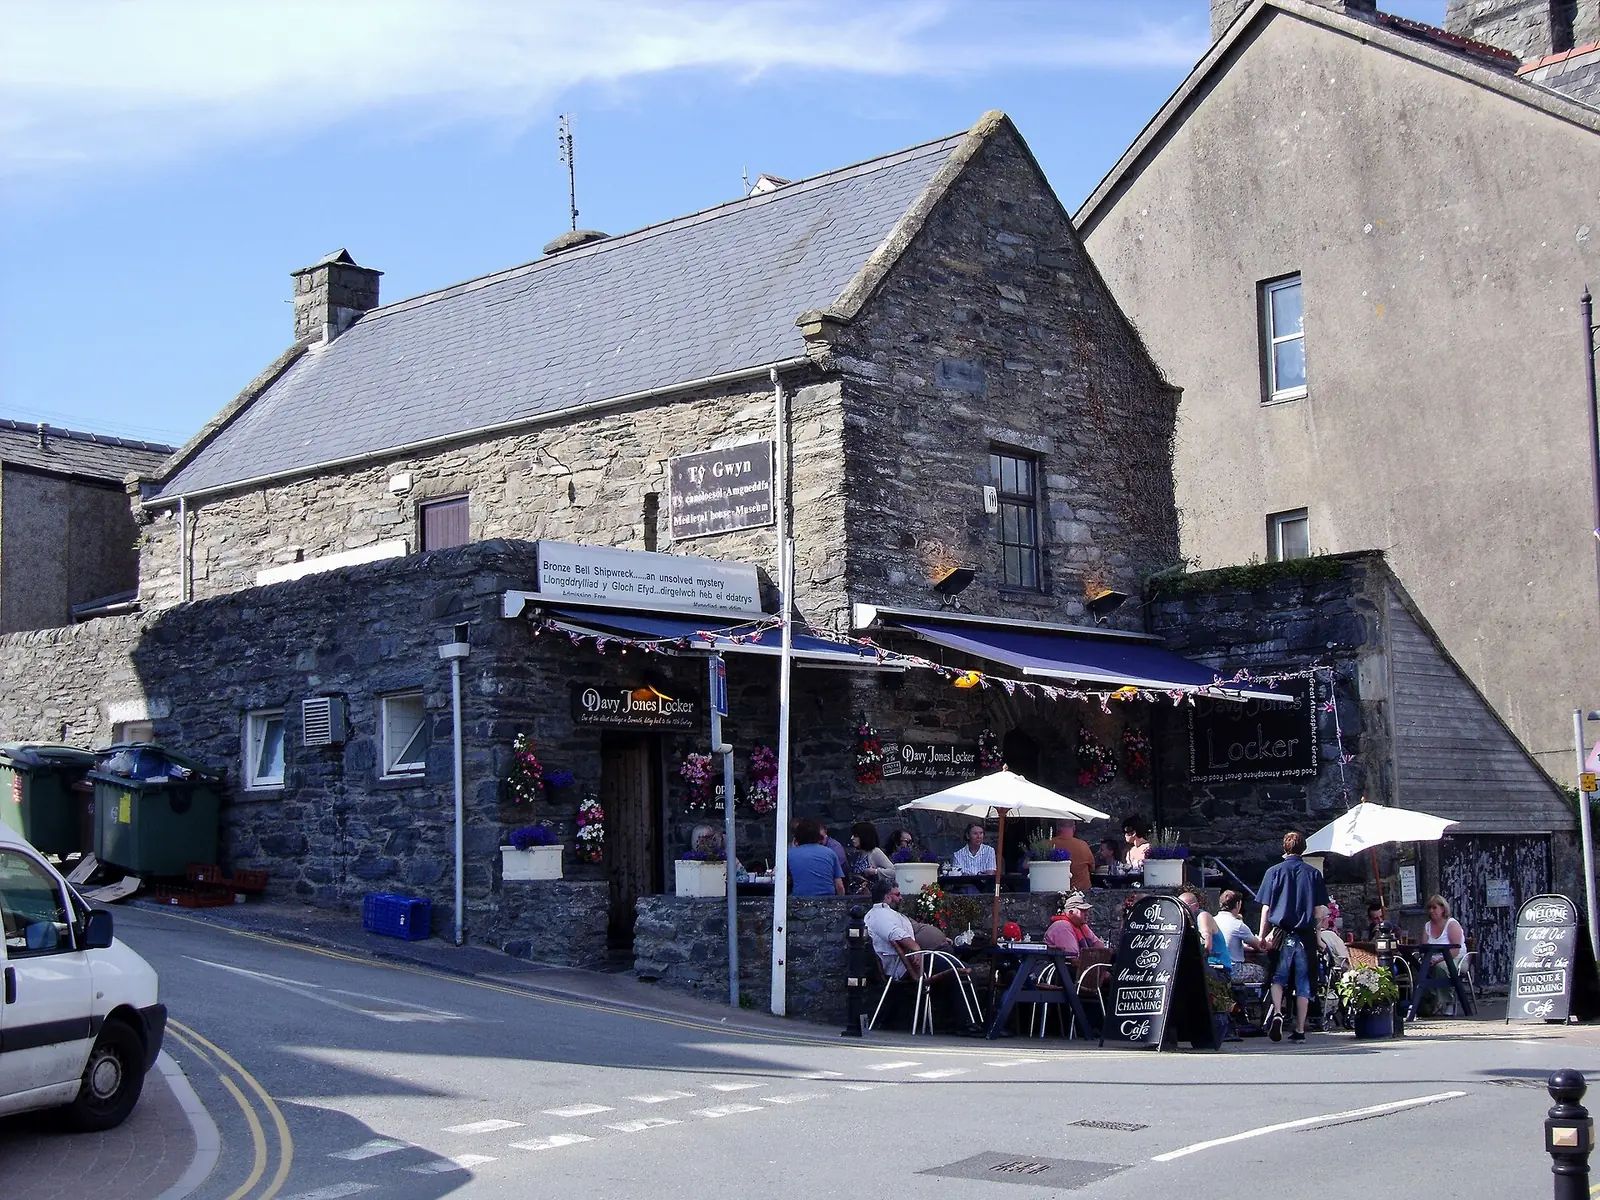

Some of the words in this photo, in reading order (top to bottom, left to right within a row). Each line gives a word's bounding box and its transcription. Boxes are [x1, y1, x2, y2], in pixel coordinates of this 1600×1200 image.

[713, 460, 751, 478] Gwyn
[673, 511, 708, 526] Medieval
[543, 560, 571, 573] Bronze
[575, 565, 590, 575] Bell
[659, 574, 693, 585] unsolved
[697, 578, 725, 590] mystery
[543, 574, 599, 589] Llongddrylliad
[602, 582, 608, 592] y
[612, 581, 634, 592] Gloch
[699, 589, 713, 600] heb
[716, 592, 723, 600] ei
[725, 593, 753, 605] ddatrys
[582, 687, 620, 713] Davy
[620, 689, 657, 714] Jones
[658, 695, 694, 716] Locker
[1207, 723, 1300, 769] Locker
[902, 744, 927, 764] Davy
[927, 745, 950, 763] Jones
[951, 746, 975, 765] Locker
[1525, 908, 1568, 921] WELCOME
[1145, 922, 1159, 930] Jones
[1160, 922, 1177, 930] Locker
[1525, 927, 1550, 940] Chill
[1549, 927, 1566, 940] Out
[1130, 934, 1155, 949] Chill
[1154, 934, 1171, 949] Out
[1515, 956, 1545, 968] Unwind
[1544, 958, 1552, 968] in
[1554, 957, 1569, 968] this
[1118, 968, 1147, 982] Unwind
[1146, 971, 1154, 982] in
[1155, 969, 1170, 983] this
[1521, 974, 1553, 984] UNIQUE
[1554, 973, 1561, 981] &
[1121, 990, 1153, 1001] UNIQUE
[1154, 988, 1161, 999] &
[1519, 982, 1563, 994] CHARMING
[1118, 1000, 1161, 1011] CHARMING
